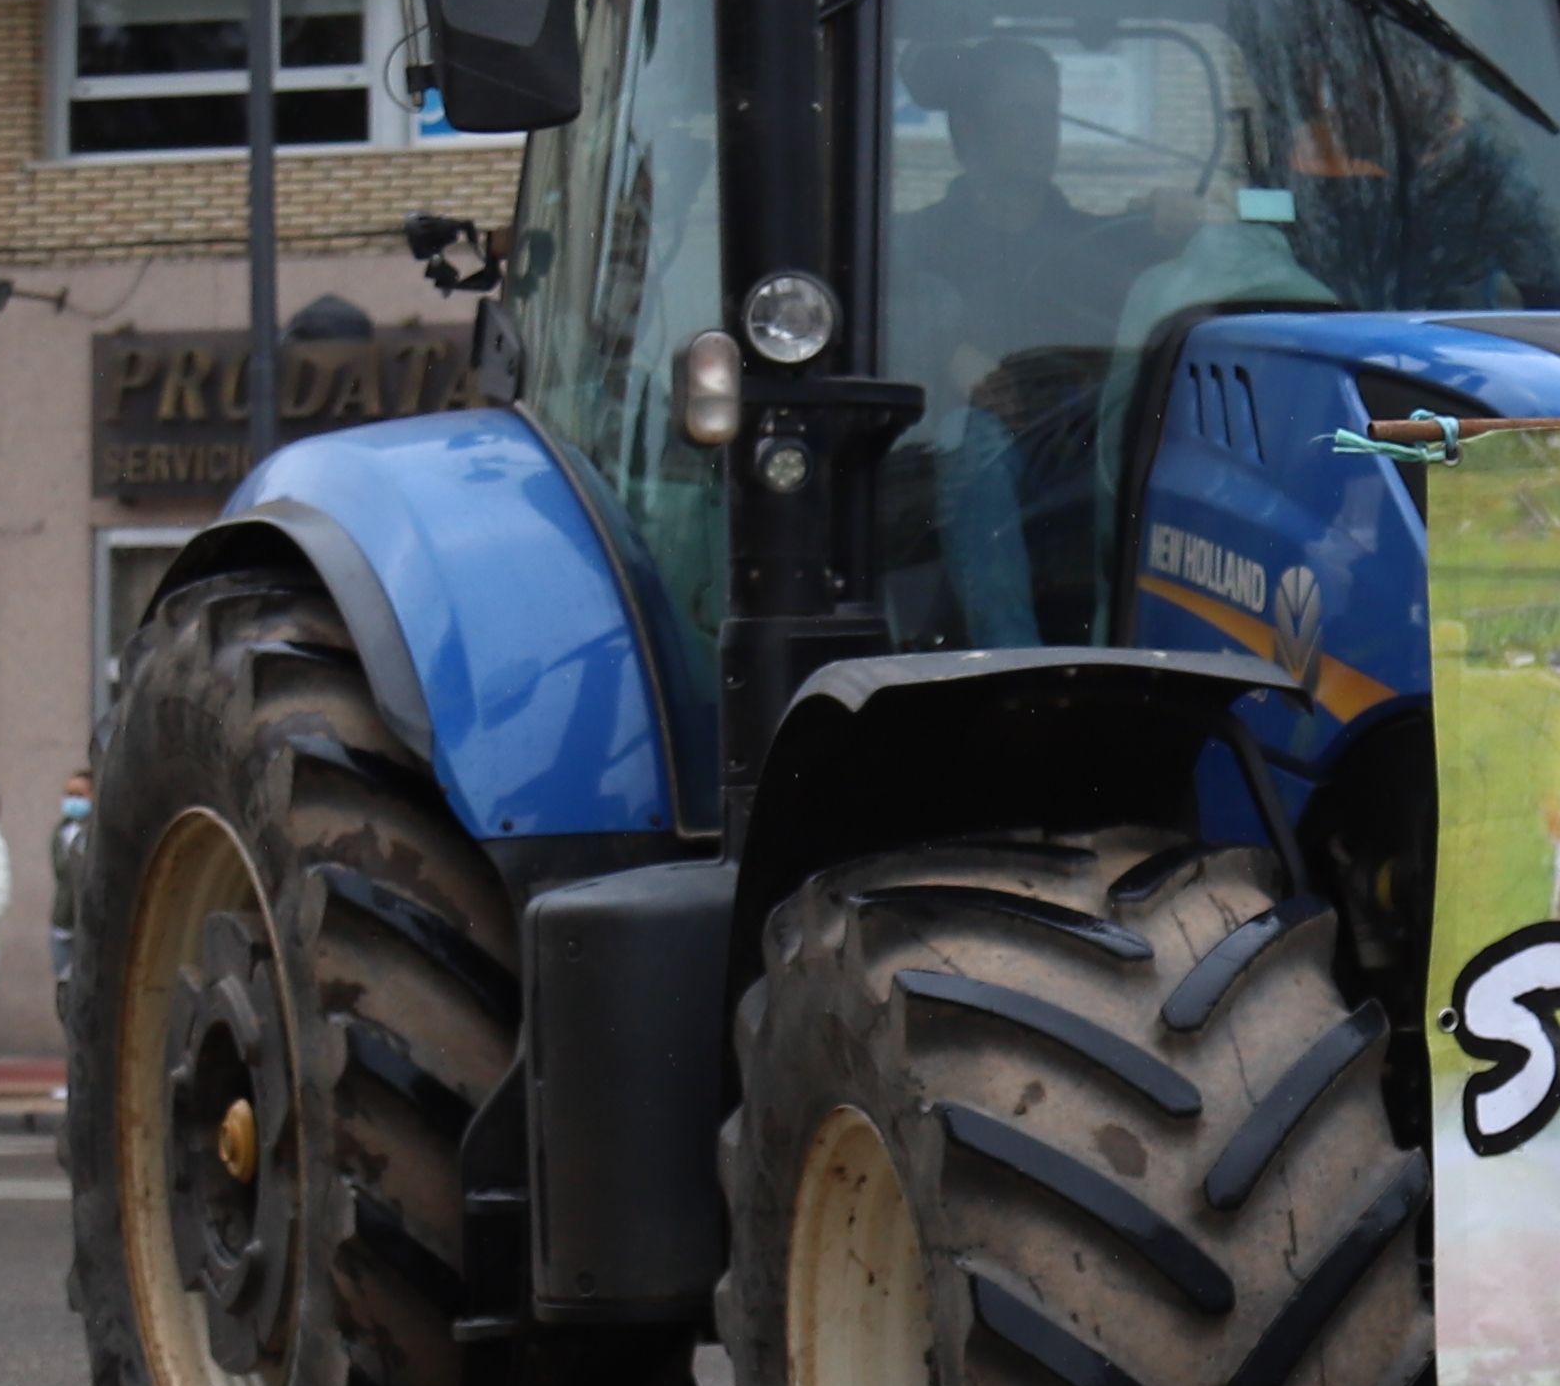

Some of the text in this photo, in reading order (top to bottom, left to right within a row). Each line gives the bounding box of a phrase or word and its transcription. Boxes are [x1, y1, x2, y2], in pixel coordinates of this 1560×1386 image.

[104, 442, 253, 481] SERVICI
[1150, 522, 1267, 613] NEW HOLLAND
